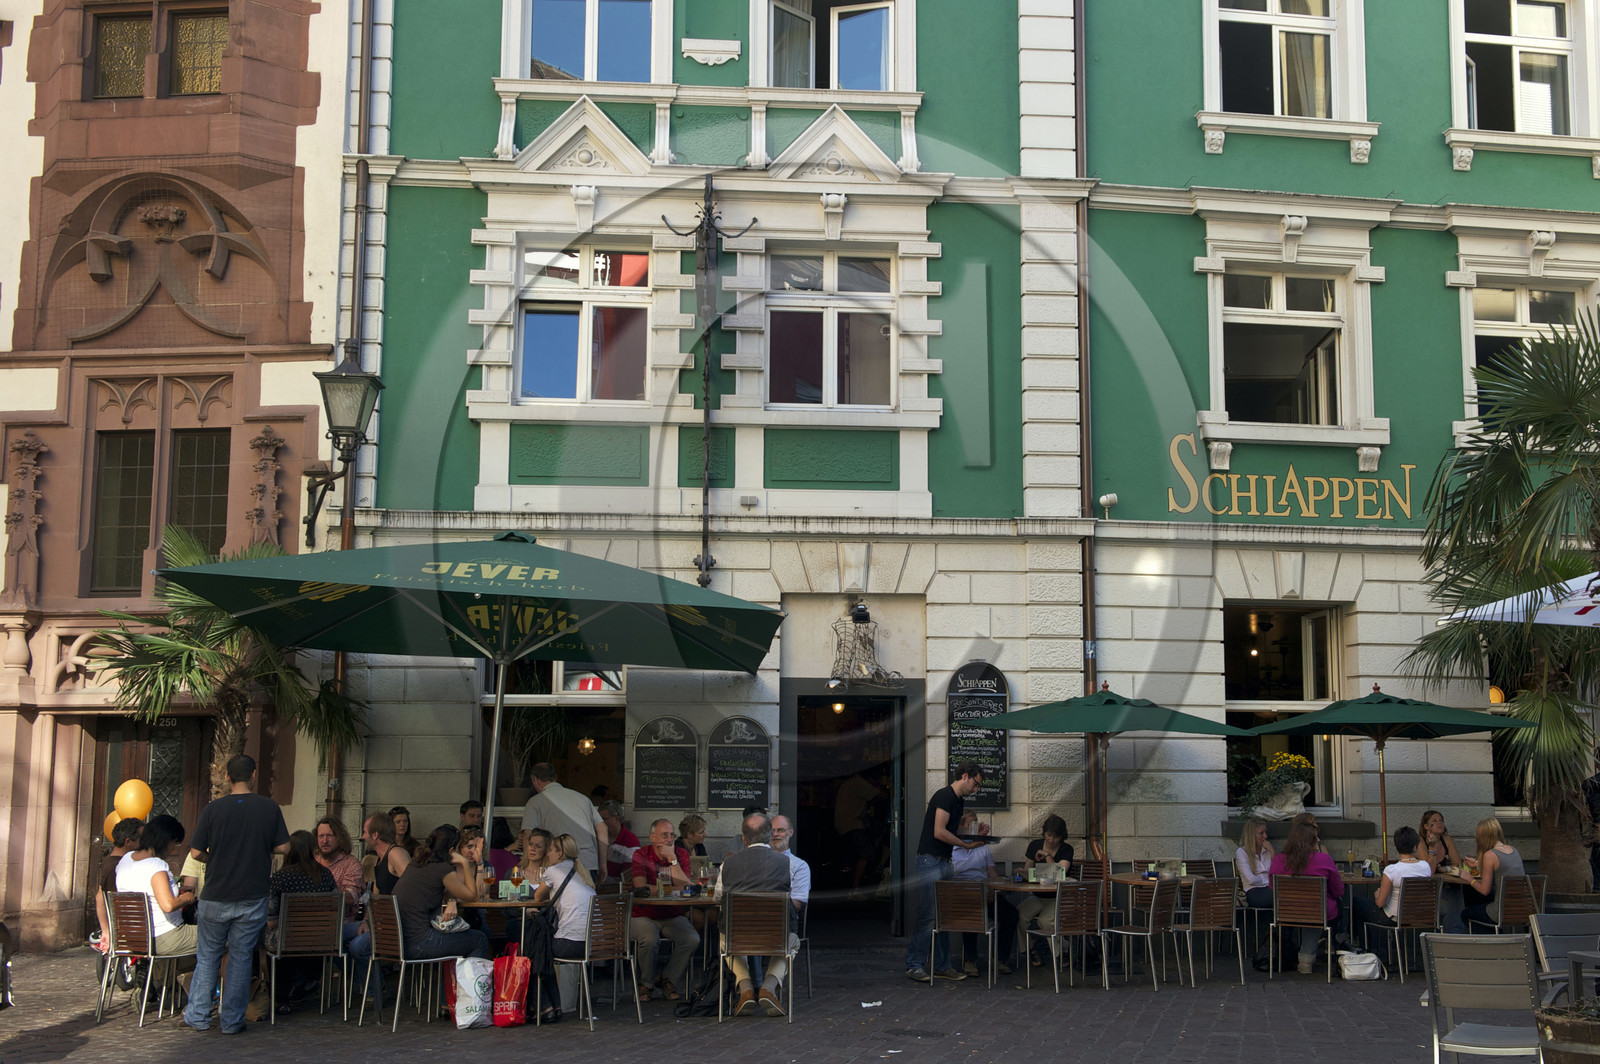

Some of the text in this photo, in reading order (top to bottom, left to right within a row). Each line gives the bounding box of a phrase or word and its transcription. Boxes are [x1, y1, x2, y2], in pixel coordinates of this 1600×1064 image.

[1167, 432, 1417, 520] SCHLAPPEN
[421, 561, 560, 581] JEVER
[957, 673, 997, 688] SCHLAPPEN
[159, 717, 177, 727] 250
